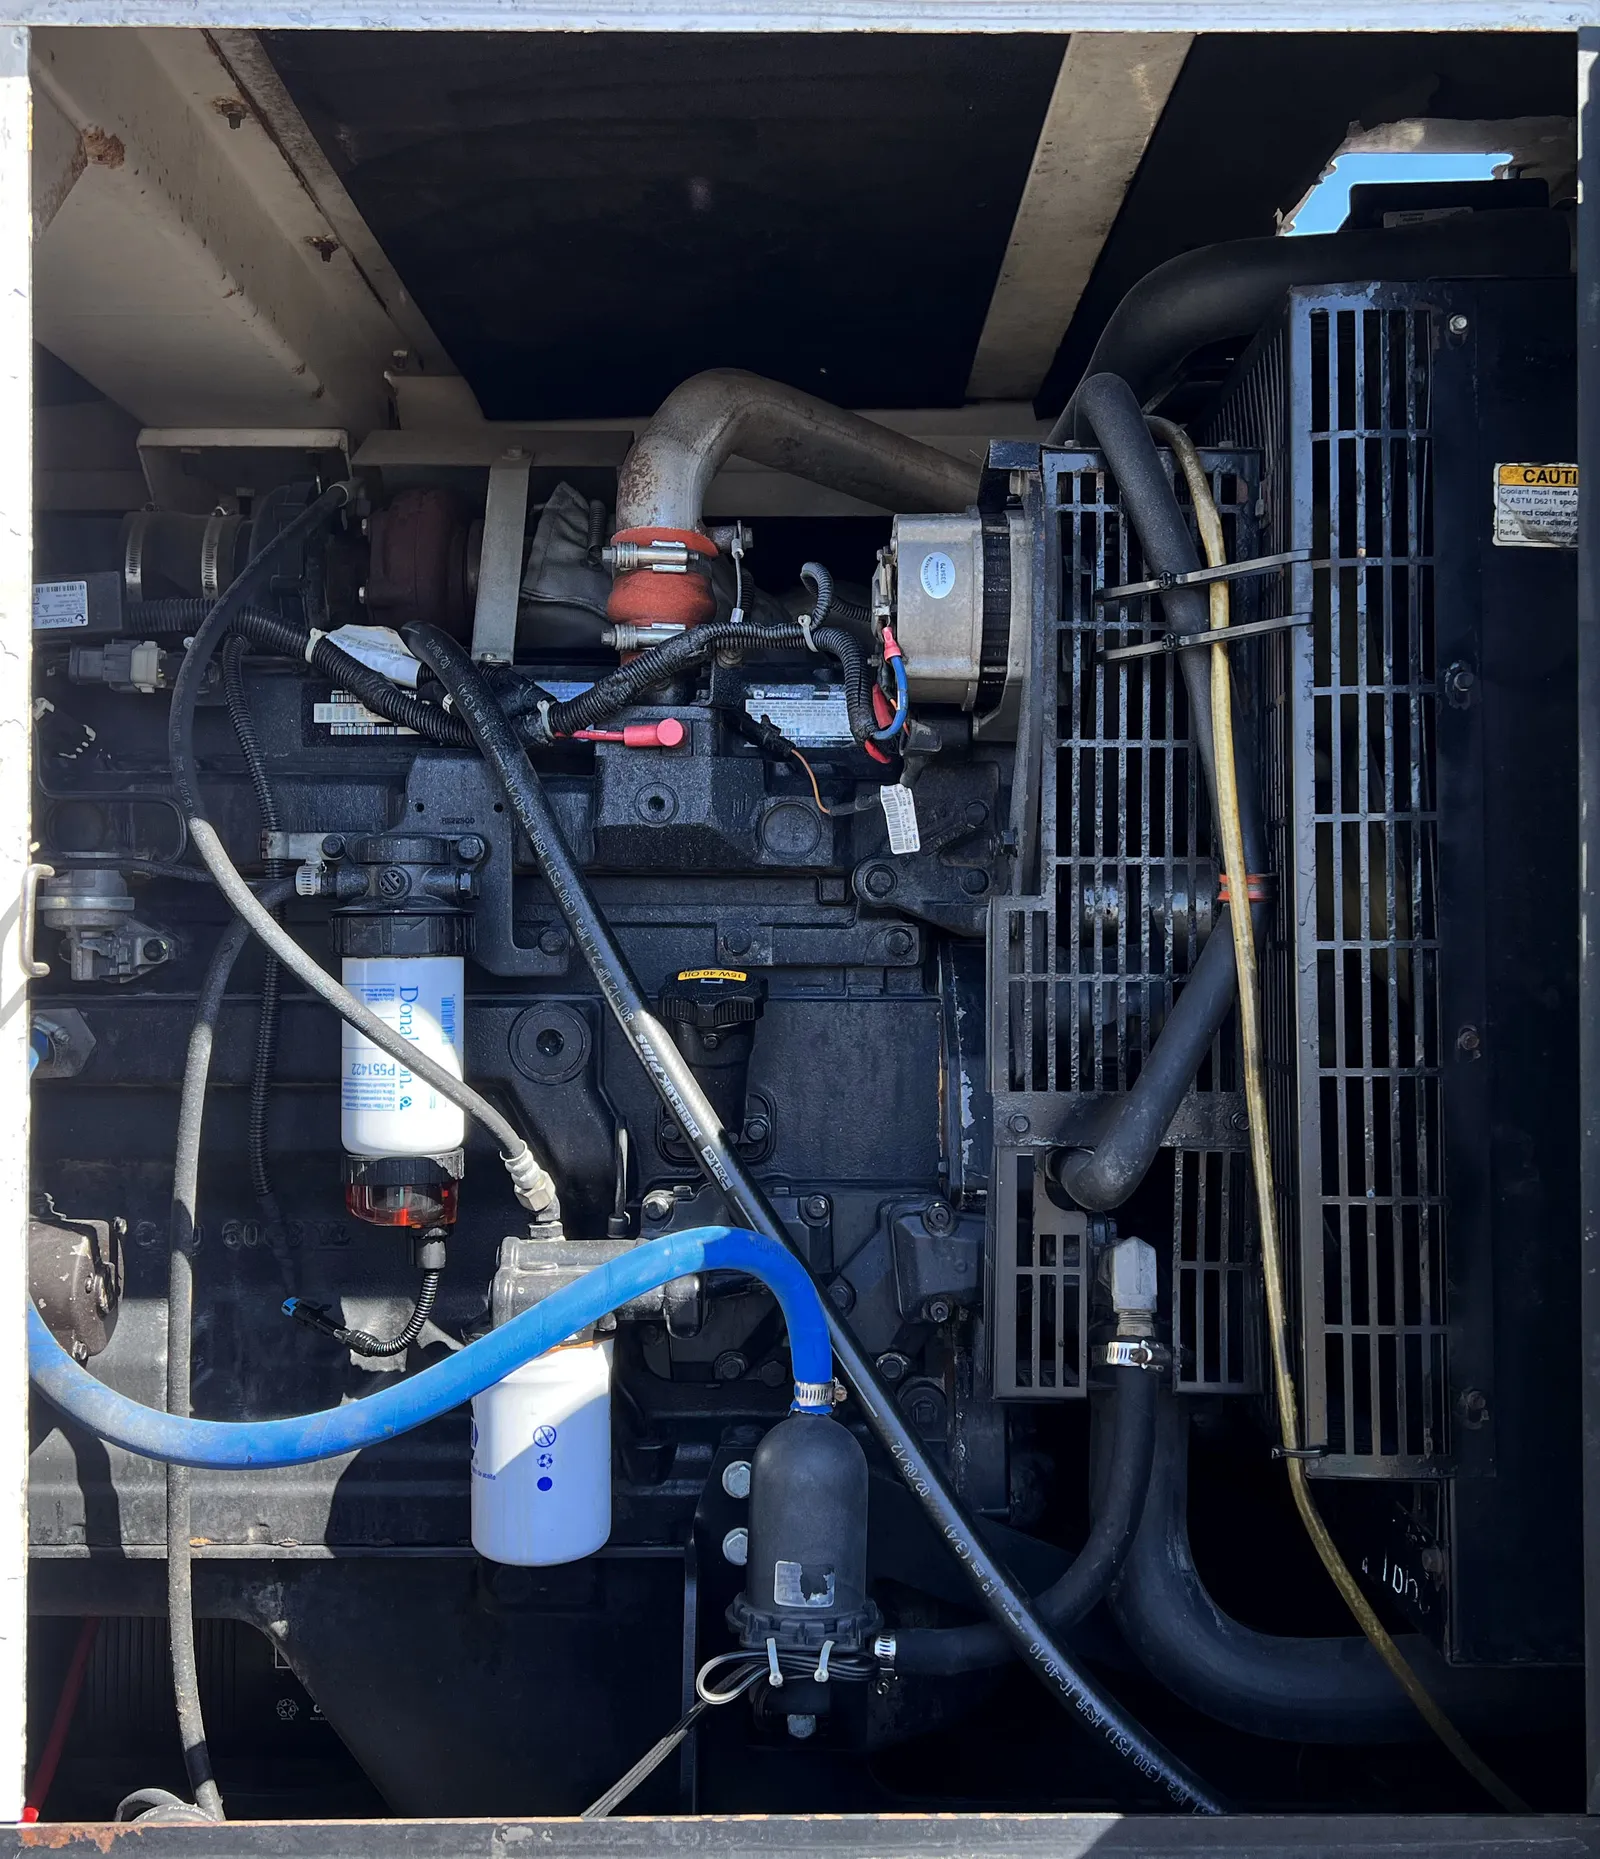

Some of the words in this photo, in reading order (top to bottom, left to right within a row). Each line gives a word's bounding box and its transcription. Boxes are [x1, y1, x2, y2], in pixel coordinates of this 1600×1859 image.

[542, 859, 564, 888] PSI)
[557, 887, 578, 915] (300
[572, 916, 591, 940] MPa
[597, 964, 612, 981] WP
[606, 981, 634, 1022] 801-12
[632, 1031, 666, 1077] Plus
[352, 1064, 395, 1075] P551422
[701, 1146, 732, 1189] Parker
[889, 1440, 931, 1498] 02/08/12
[943, 1524, 970, 1560] (3/4)
[1029, 1641, 1071, 1697] IC-40/10
[1104, 1727, 1133, 1756] PSI)
[1132, 1753, 1162, 1783] (300
[1165, 1780, 1189, 1806] MPa
